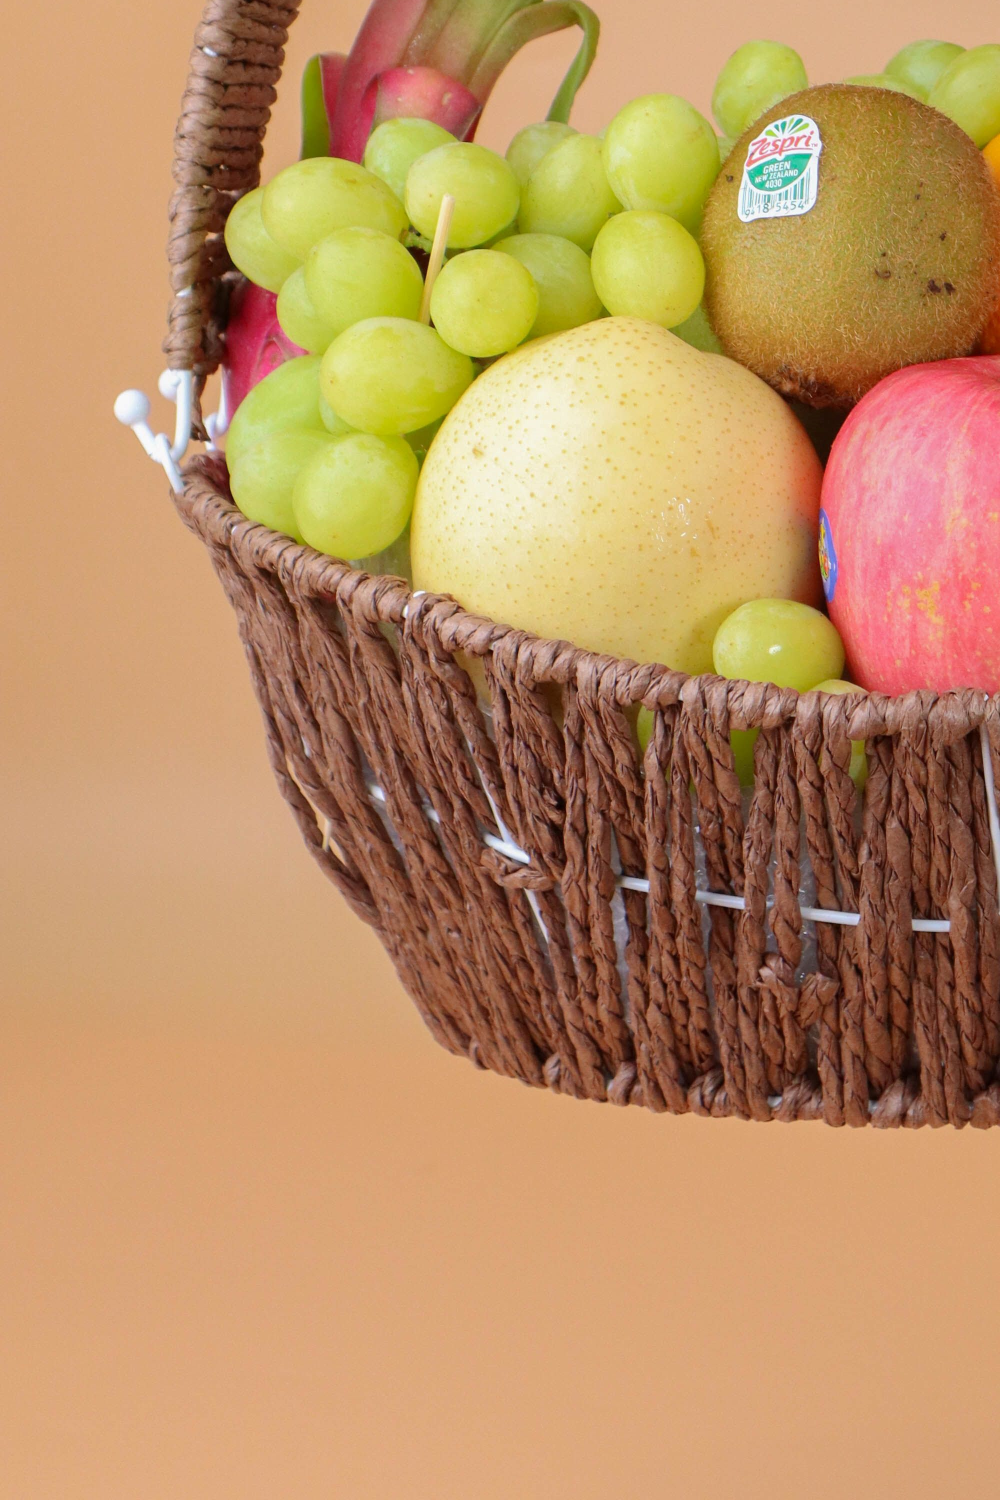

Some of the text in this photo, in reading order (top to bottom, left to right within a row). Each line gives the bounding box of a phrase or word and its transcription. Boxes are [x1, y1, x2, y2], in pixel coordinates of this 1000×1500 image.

[746, 131, 814, 167] Zespri
[763, 161, 791, 174] GREEN
[754, 169, 799, 184] NEW ZEALAND
[765, 179, 782, 189] 4030
[776, 200, 804, 212] 5454
